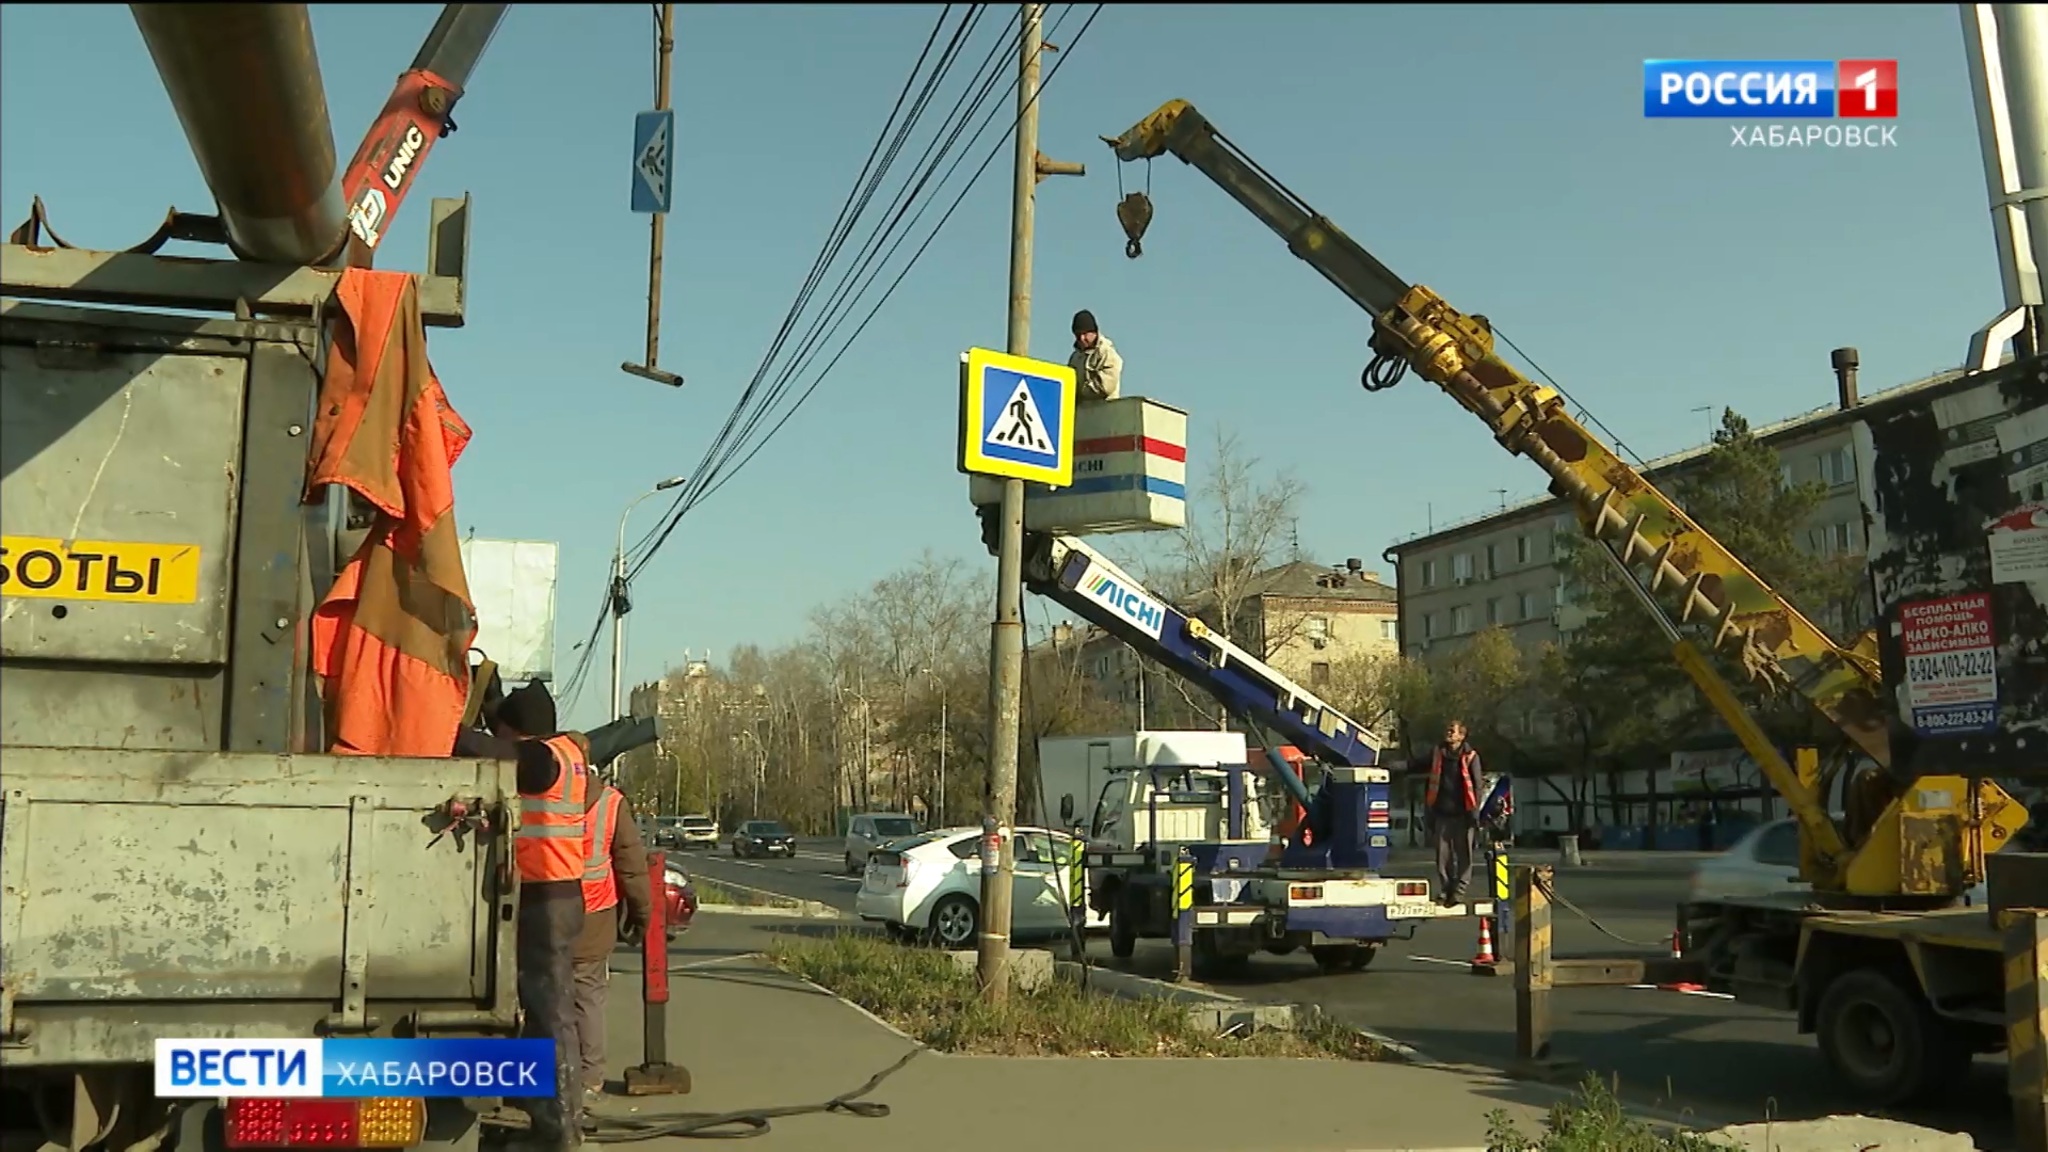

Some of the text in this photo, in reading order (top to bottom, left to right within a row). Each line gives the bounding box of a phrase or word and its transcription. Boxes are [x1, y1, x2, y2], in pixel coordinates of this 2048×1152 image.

[383, 125, 423, 190] UNIC
[0, 547, 161, 596] ОТЫ
[1096, 579, 1162, 632] AICHI
[1903, 598, 1985, 618] БЕСПЛАТНАЯ
[1915, 611, 1975, 626] ПОМОЩЬ
[1905, 620, 1989, 642] НАРКО-АЛКО
[1908, 636, 1991, 653] ЗАВИСИМЫМ
[1910, 650, 1993, 682] 8-924-103-22-22
